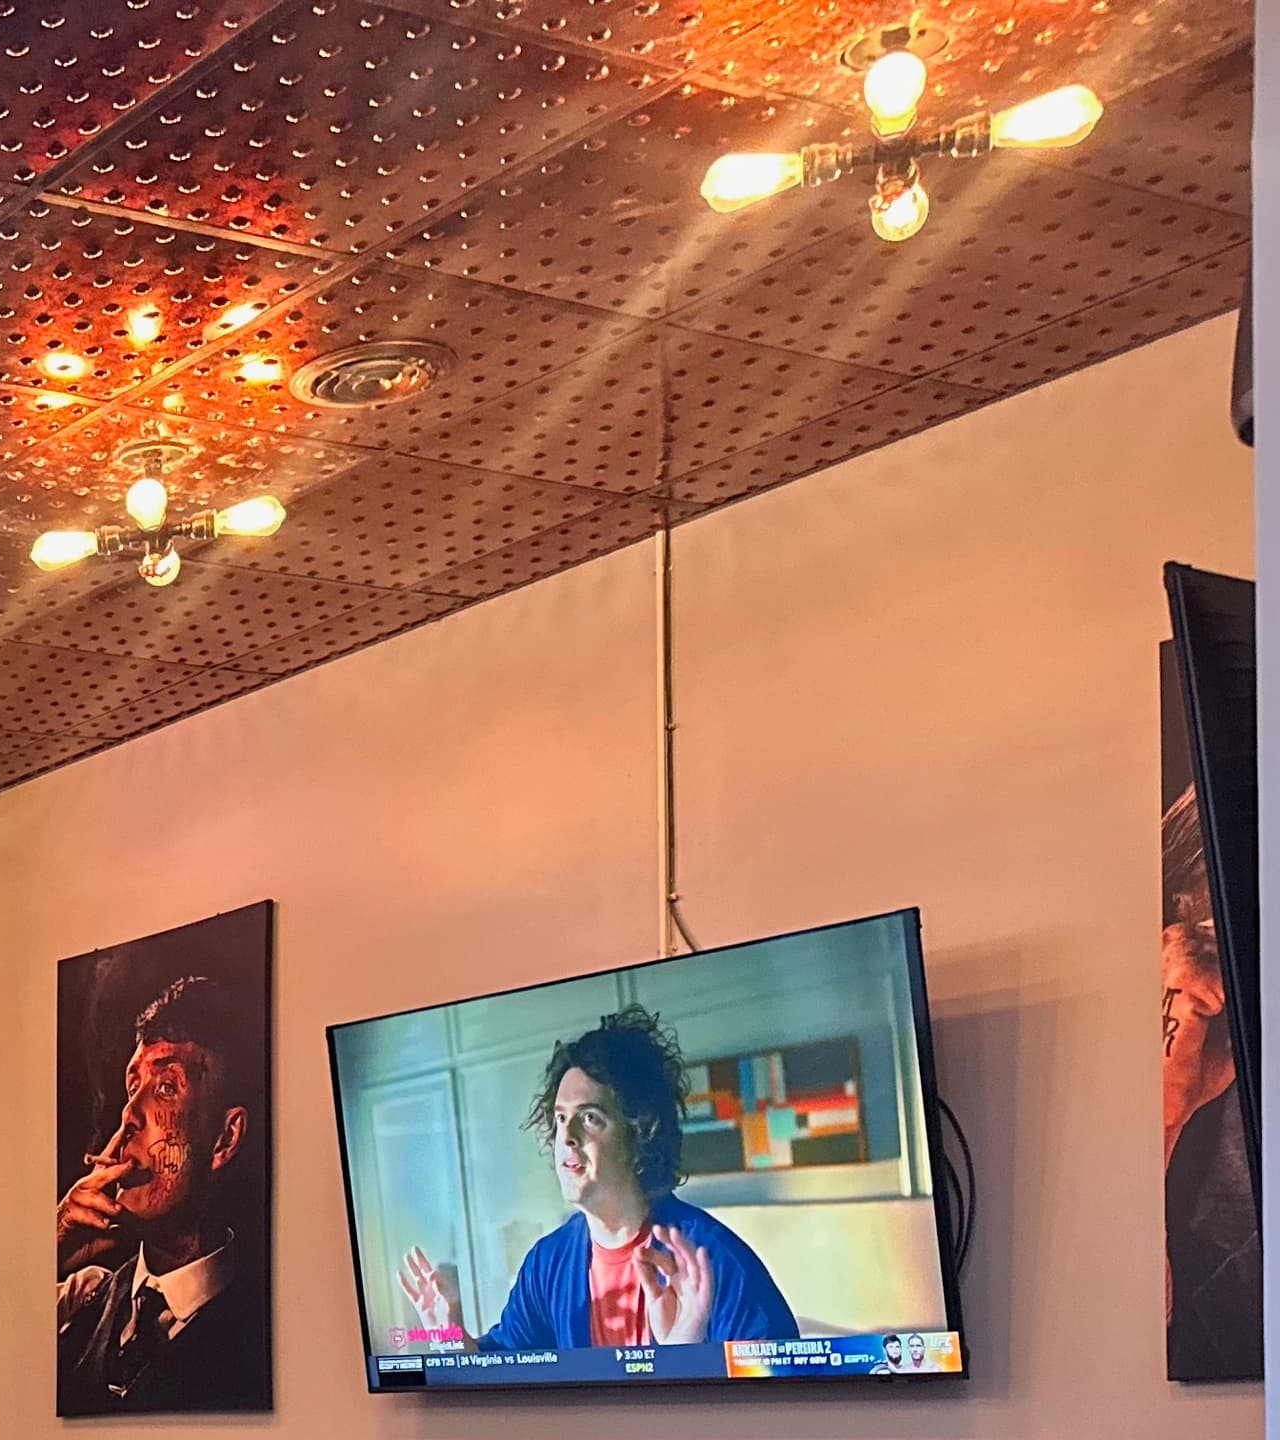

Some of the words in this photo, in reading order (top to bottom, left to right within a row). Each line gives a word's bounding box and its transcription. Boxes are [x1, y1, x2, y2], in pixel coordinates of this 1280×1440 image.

[644, 1349, 655, 1360] ET
[825, 1340, 831, 1355] 2
[470, 1354, 502, 1368] Virginia
[505, 1356, 514, 1364] vs
[517, 1352, 557, 1364] Louisville
